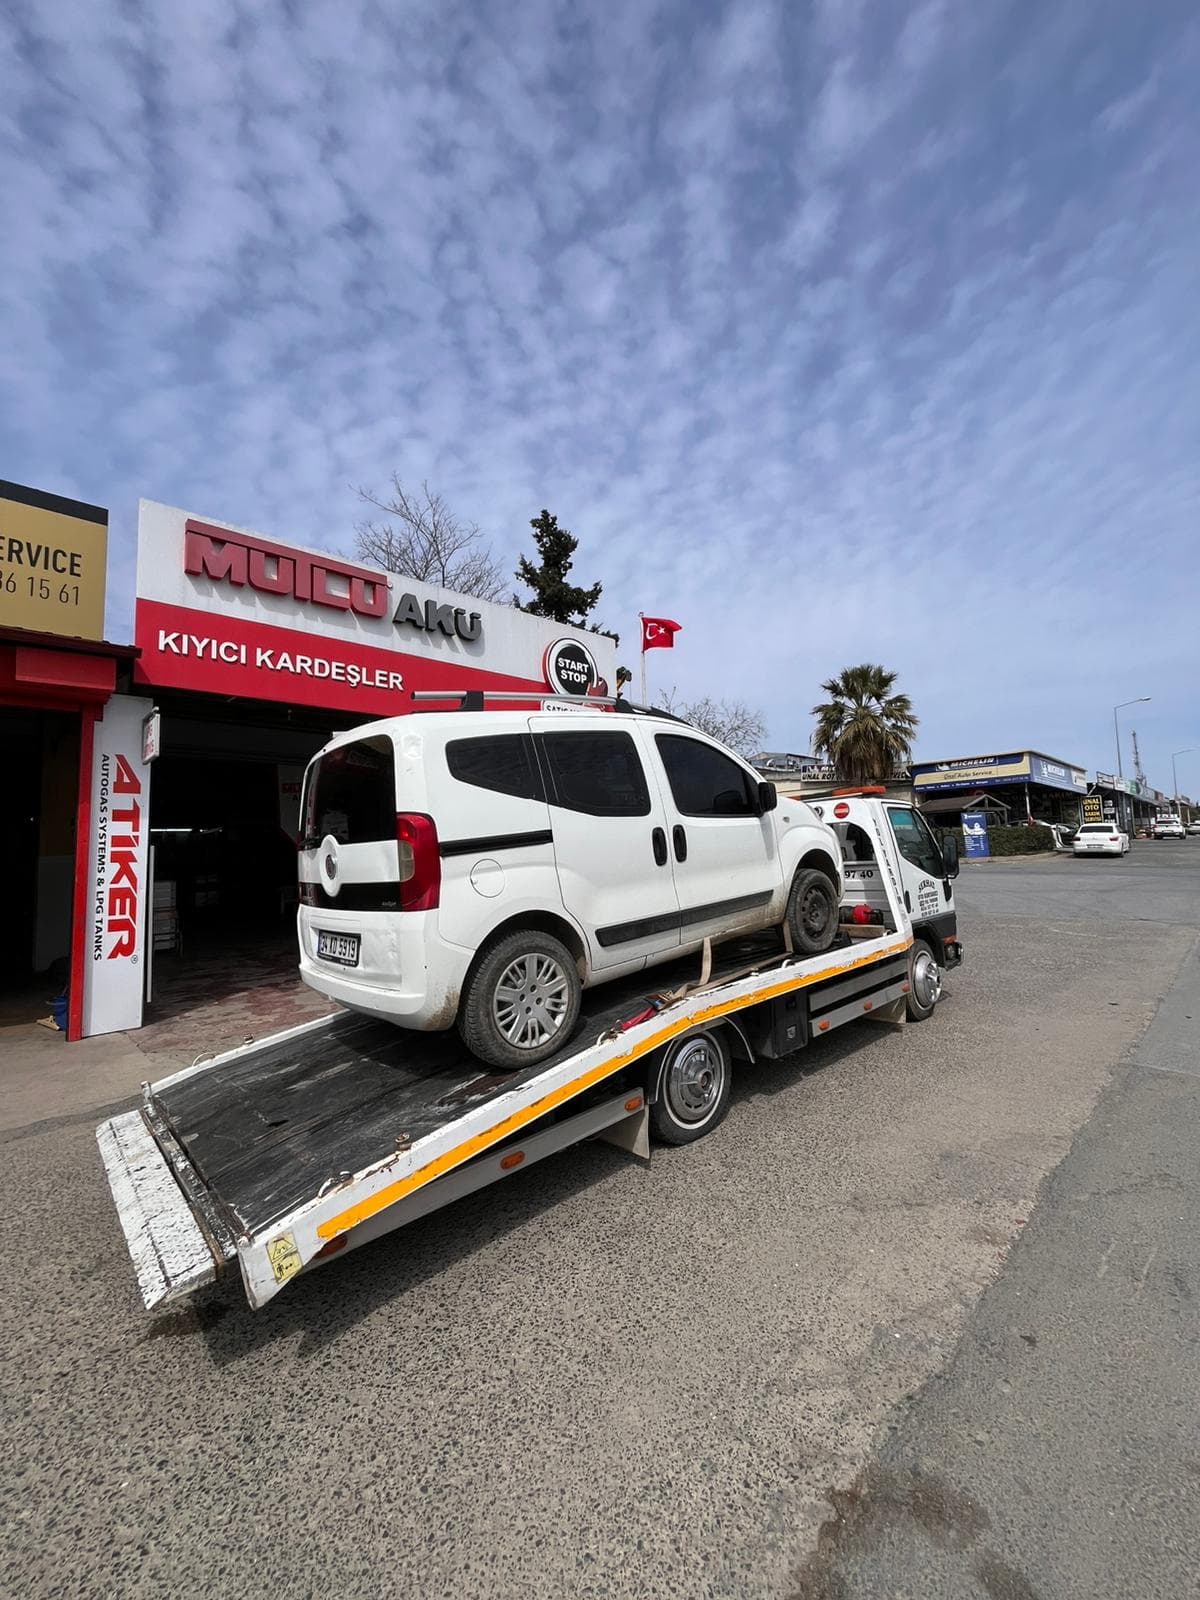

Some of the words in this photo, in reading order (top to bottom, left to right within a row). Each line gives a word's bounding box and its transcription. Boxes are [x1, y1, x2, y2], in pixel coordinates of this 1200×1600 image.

[0, 569, 16, 593] 6
[27, 576, 50, 600] 15
[59, 584, 80, 606] 61
[392, 592, 482, 641] AKÜ
[158, 629, 248, 665] KIYICI
[256, 647, 404, 691] KARDEŞLER
[557, 657, 589, 673] START
[560, 669, 588, 684] STOP
[950, 757, 995, 768] MICHELIN
[99, 753, 110, 813] AUTOGAS
[97, 816, 108, 874] SYSTEMS
[96, 878, 105, 887] &
[844, 870, 856, 879] 97
[860, 869, 874, 879] 40
[95, 891, 105, 914] LPG
[93, 918, 104, 961] TANKS
